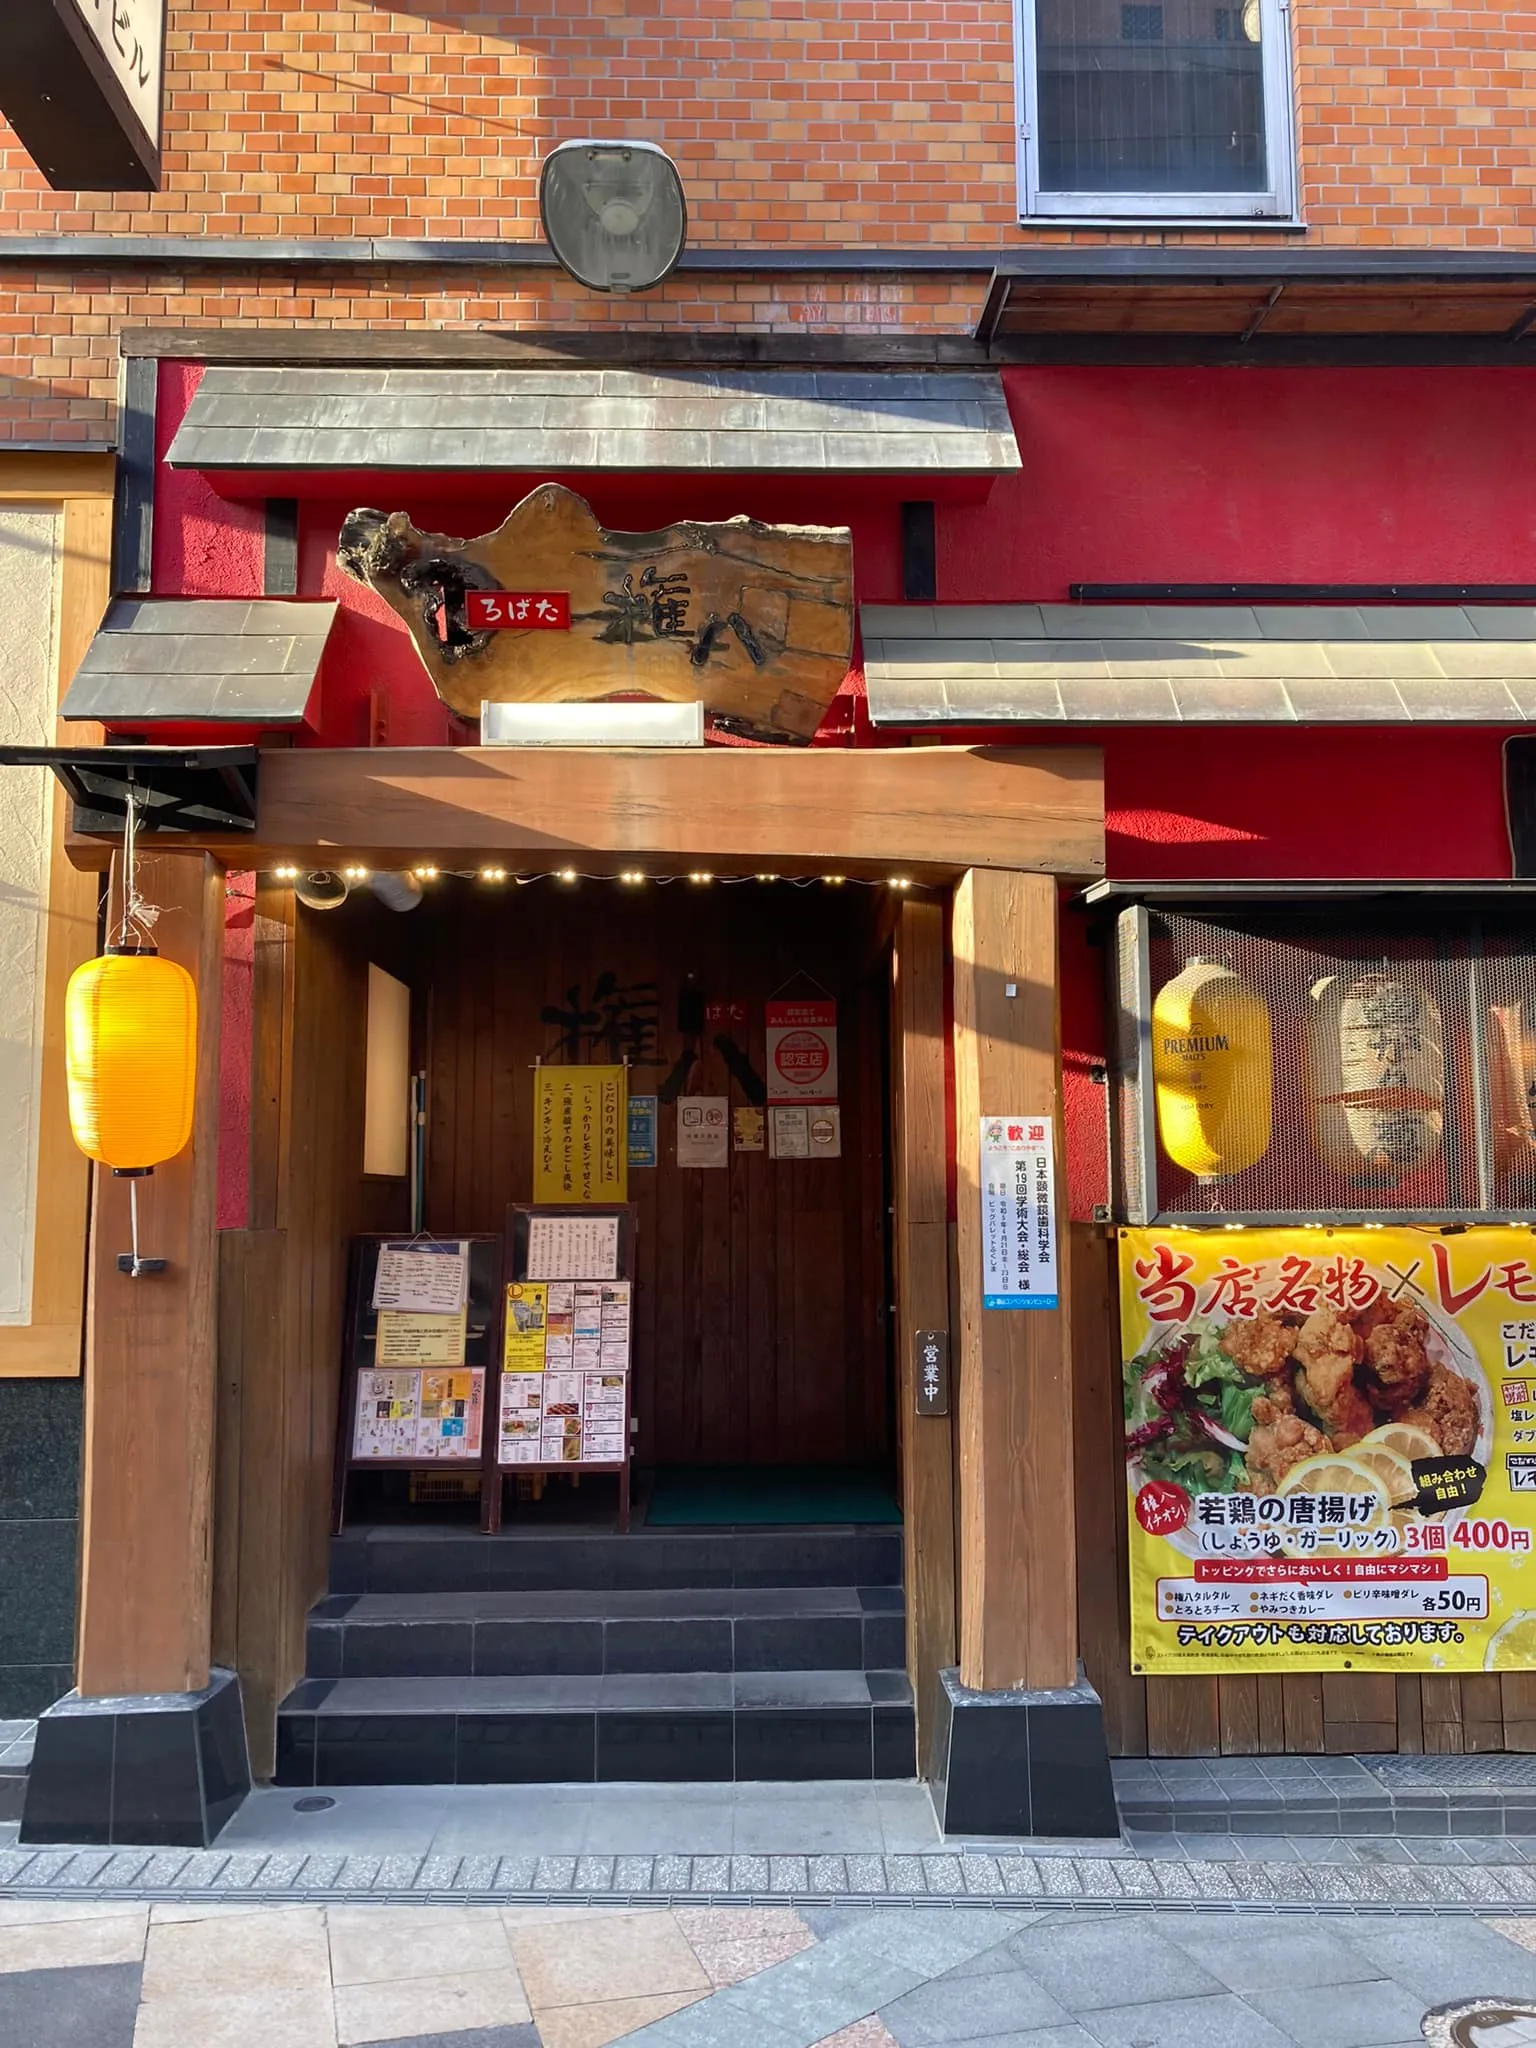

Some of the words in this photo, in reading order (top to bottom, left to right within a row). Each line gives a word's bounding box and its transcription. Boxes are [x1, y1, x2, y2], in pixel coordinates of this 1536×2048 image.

[479, 597, 559, 622] ろばた
[600, 566, 764, 666] 権八
[1164, 1034, 1229, 1054] PREMIUM
[1008, 1125, 1045, 1141] 歓迎
[1036, 1157, 1051, 1263] 日本顕微鏡歯科学会
[1018, 1279, 1031, 1290] 様
[923, 1344, 940, 1402] 営業中
[1419, 1466, 1478, 1488] 組み合わせ
[1199, 1494, 1377, 1526] 若鶏の唐揚げ
[1175, 1591, 1231, 1602] 権八タルタル
[1422, 1590, 1481, 1612] 各50円
[1175, 1604, 1240, 1615] とろとろチーズ
[1259, 1604, 1326, 1615] やみつきカレー
[1178, 1622, 1465, 1646] テイクアウトも対応しております。
